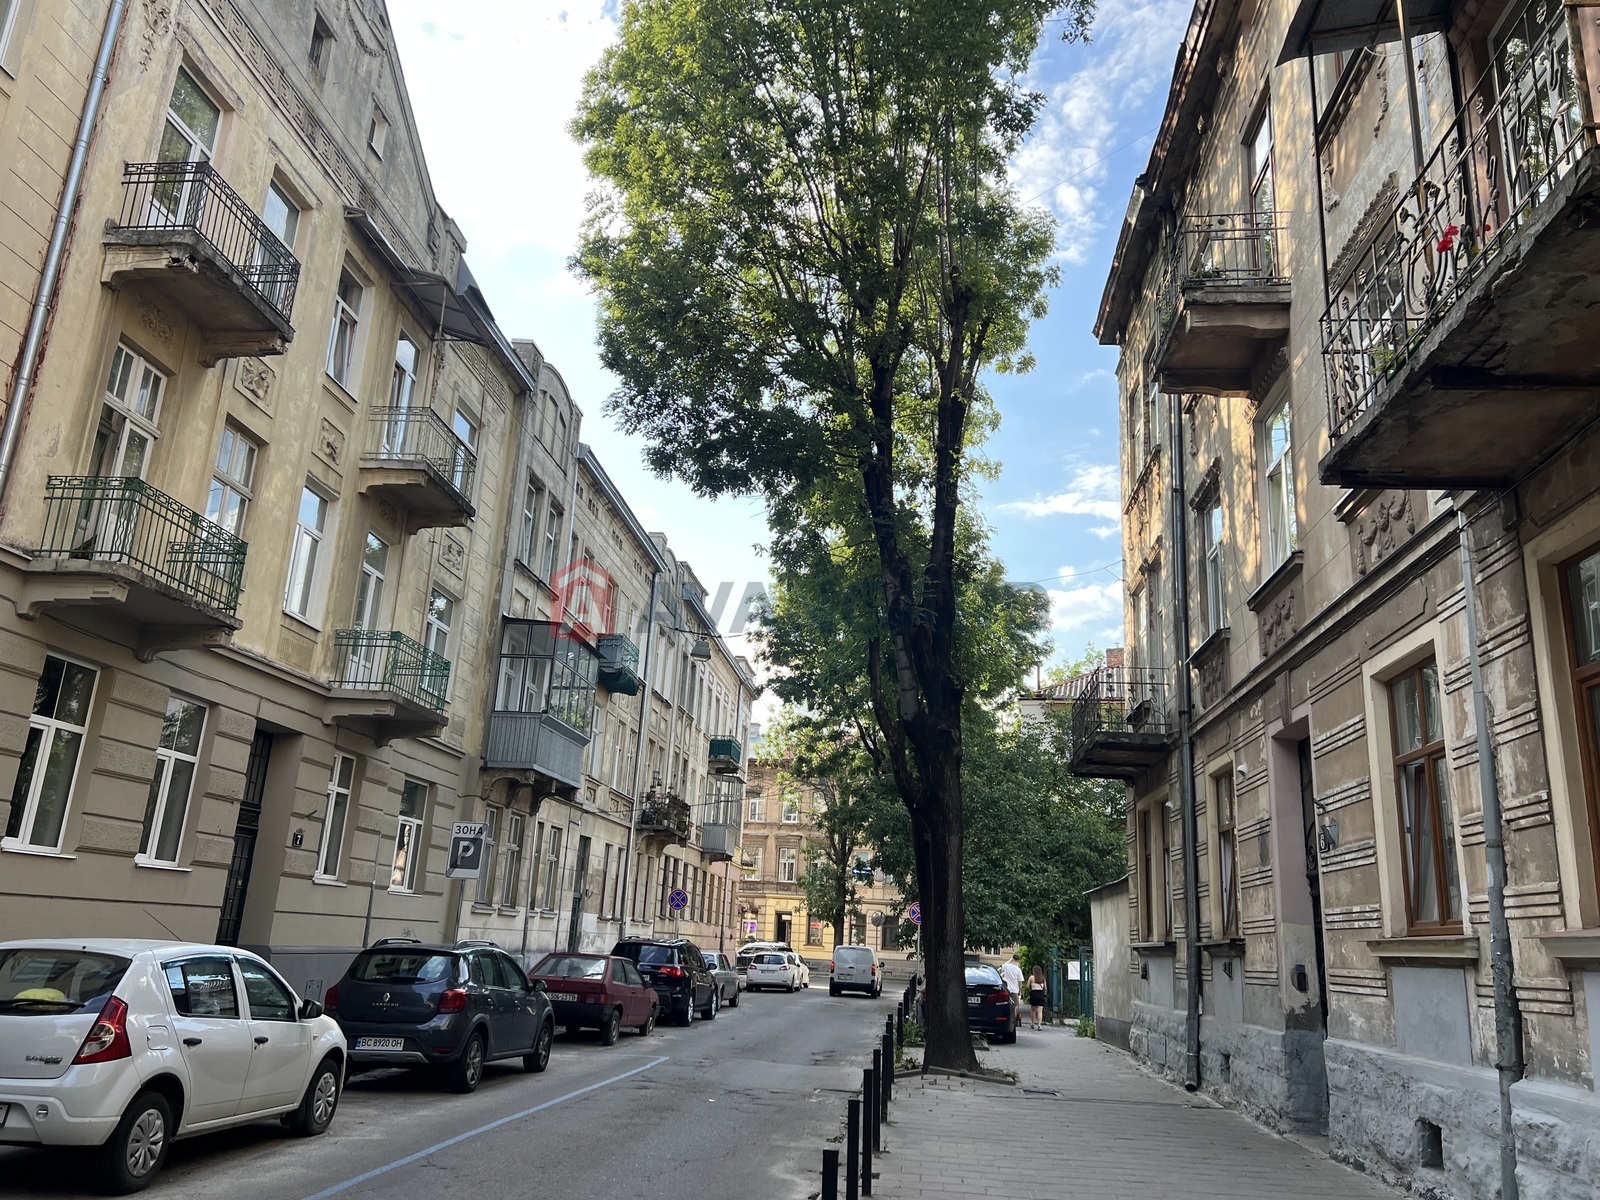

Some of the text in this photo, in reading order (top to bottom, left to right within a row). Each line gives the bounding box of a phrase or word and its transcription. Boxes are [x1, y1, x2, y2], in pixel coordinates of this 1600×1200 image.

[455, 825, 483, 836] ЗОНА
[457, 840, 475, 866] P
[361, 1038, 403, 1048] BC 8920 OH
